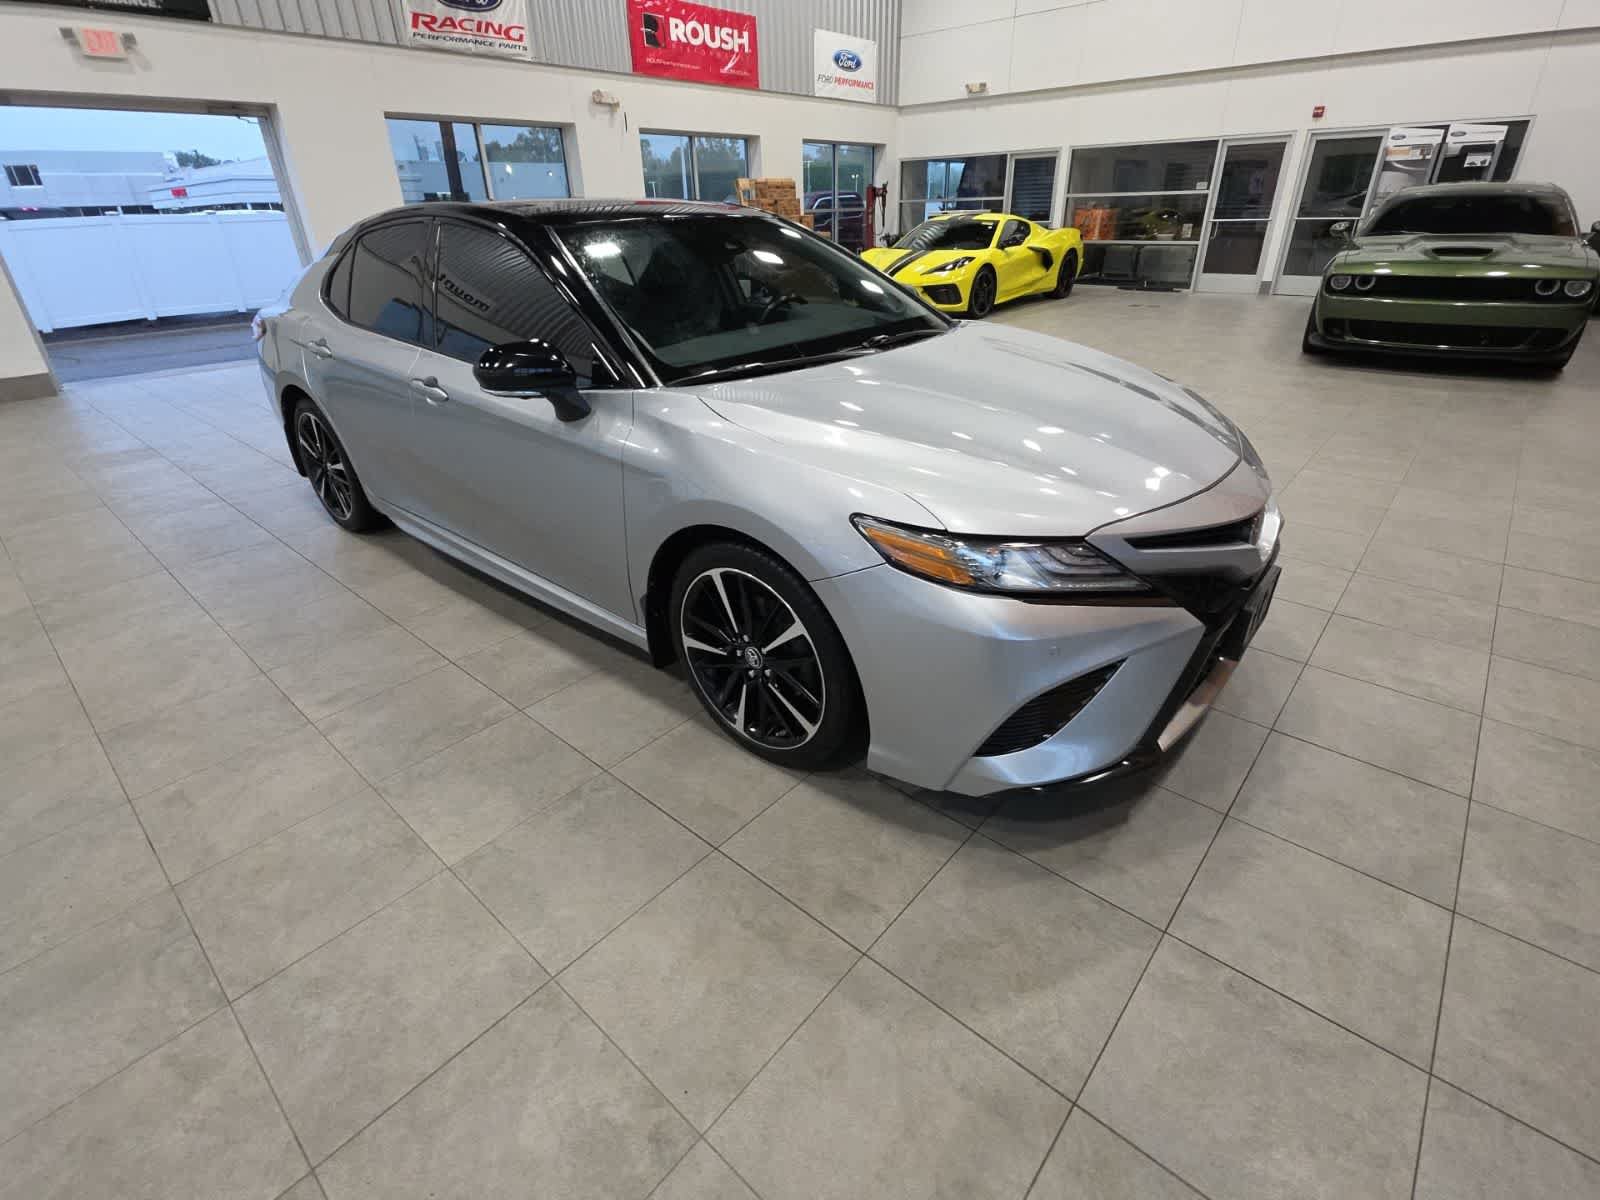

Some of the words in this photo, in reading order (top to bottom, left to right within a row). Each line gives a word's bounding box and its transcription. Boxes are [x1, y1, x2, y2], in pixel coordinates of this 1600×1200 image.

[409, 11, 526, 43] RACING
[412, 31, 495, 47] PERFORMANCE
[498, 42, 528, 52] PARTS
[669, 16, 750, 53] ROUSH
